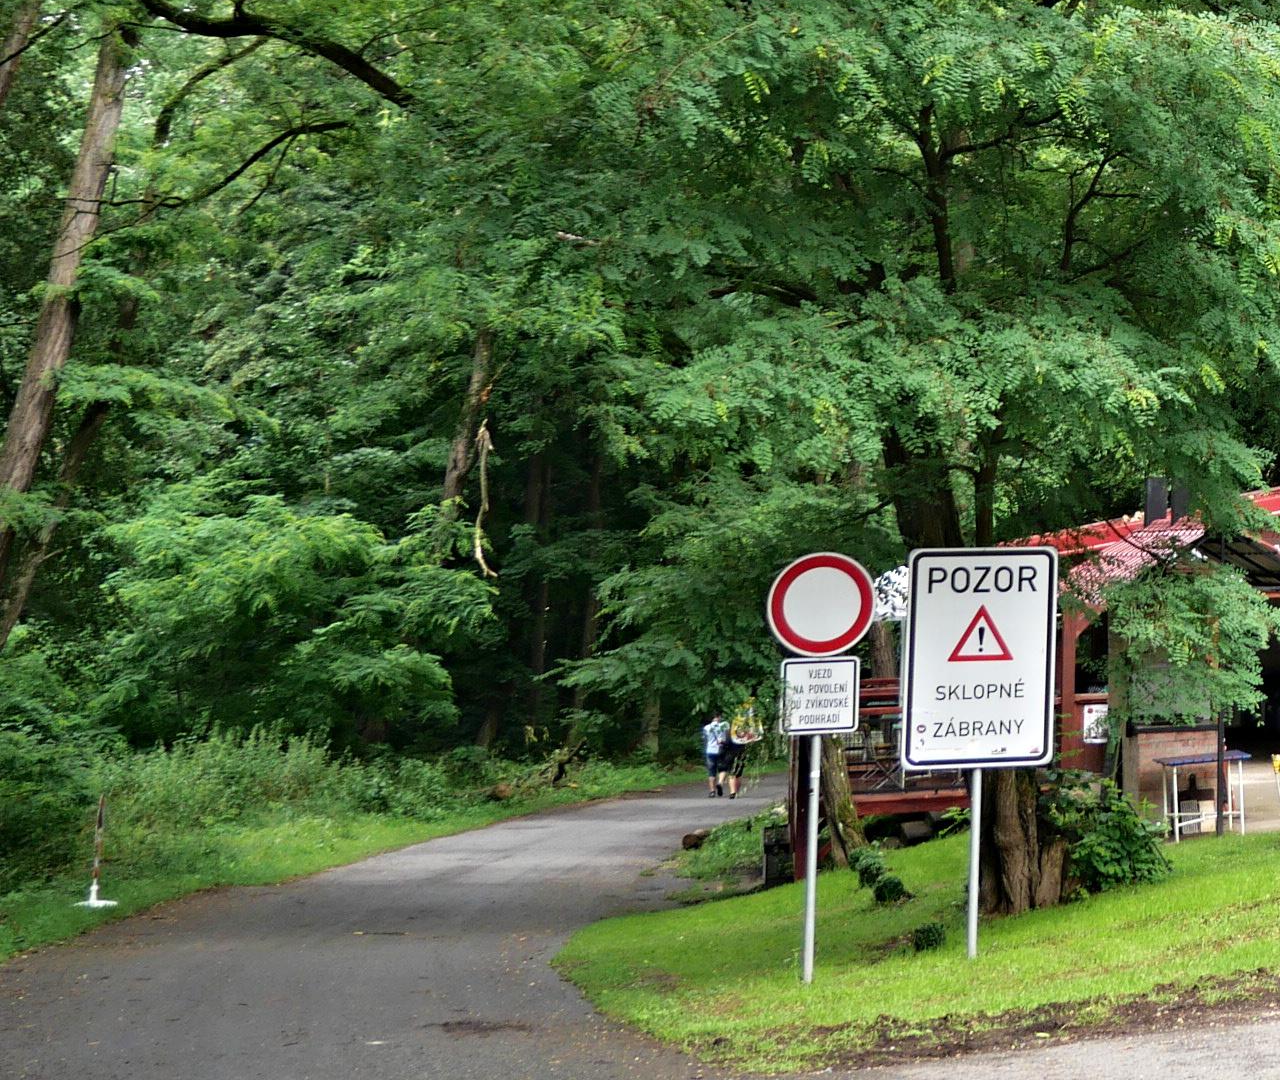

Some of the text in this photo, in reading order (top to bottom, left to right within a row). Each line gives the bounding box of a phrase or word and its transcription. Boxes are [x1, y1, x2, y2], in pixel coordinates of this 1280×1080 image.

[928, 565, 1038, 594] POZOR
[808, 668, 833, 680] VJEZD
[793, 681, 849, 695] NA POVOLENÍ
[935, 678, 1024, 700] SKLOPNÉ
[805, 695, 849, 710] ZVÍKOVSKÉ
[799, 712, 841, 726] PODHRADÍ
[932, 716, 1025, 739] ZÁBRANY
